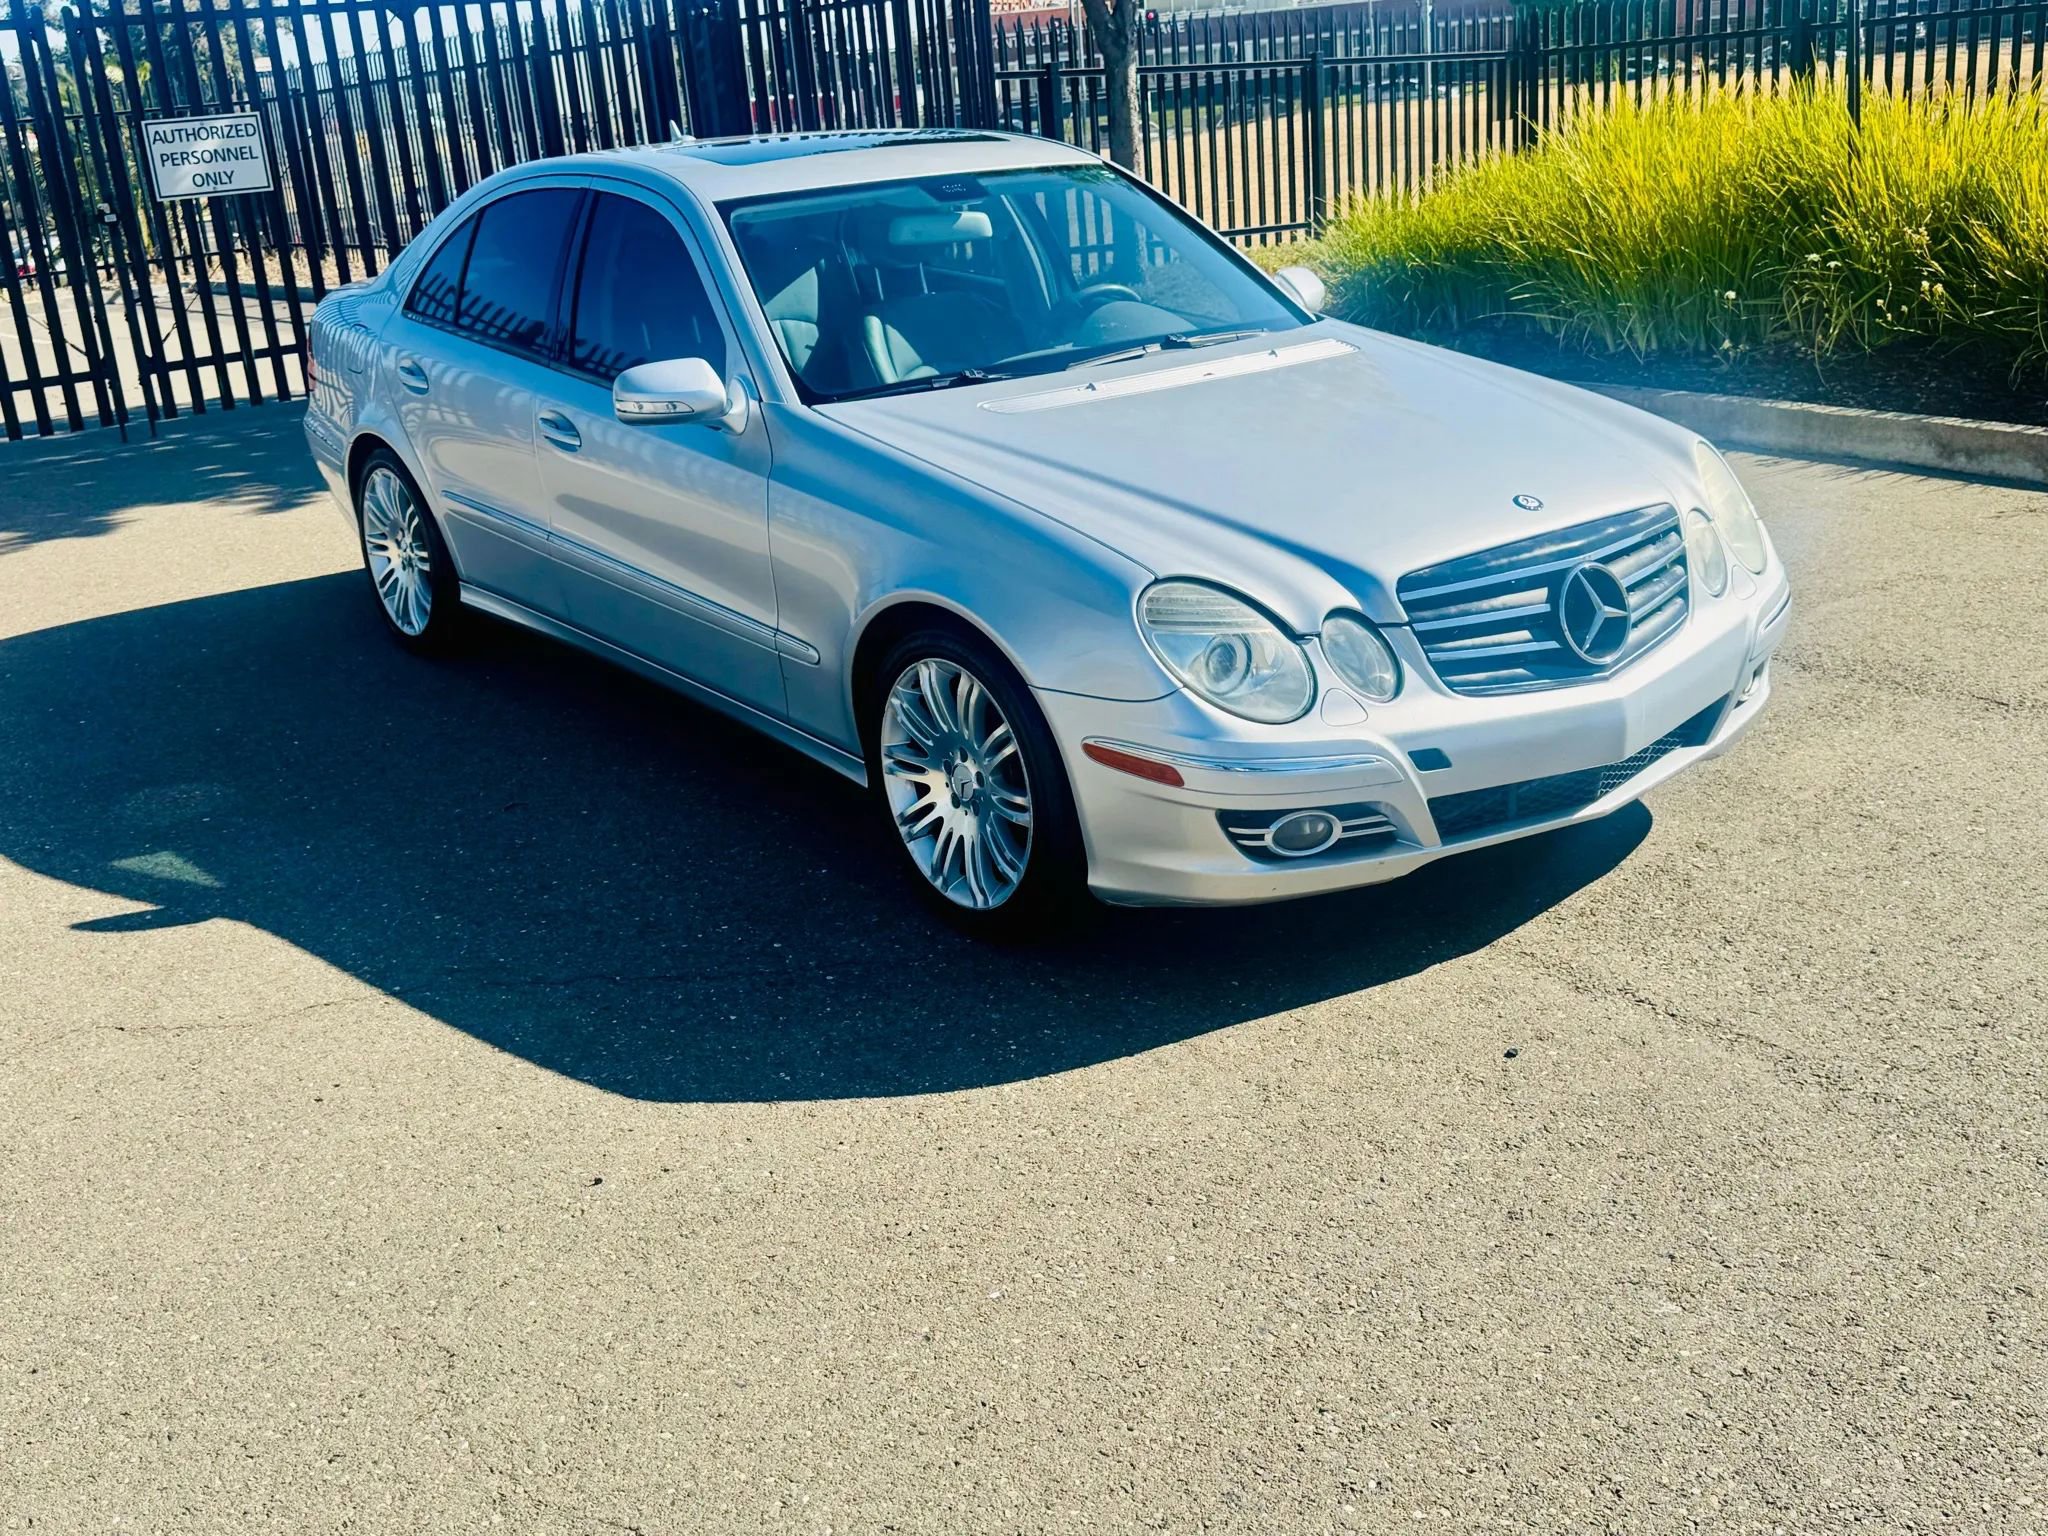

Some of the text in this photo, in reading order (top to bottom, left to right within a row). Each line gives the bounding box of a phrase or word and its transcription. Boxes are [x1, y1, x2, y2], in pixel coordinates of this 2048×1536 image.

[152, 123, 257, 145] AUTHORIZED
[160, 146, 259, 168] PERSONNEL
[192, 170, 235, 188] ONLY
